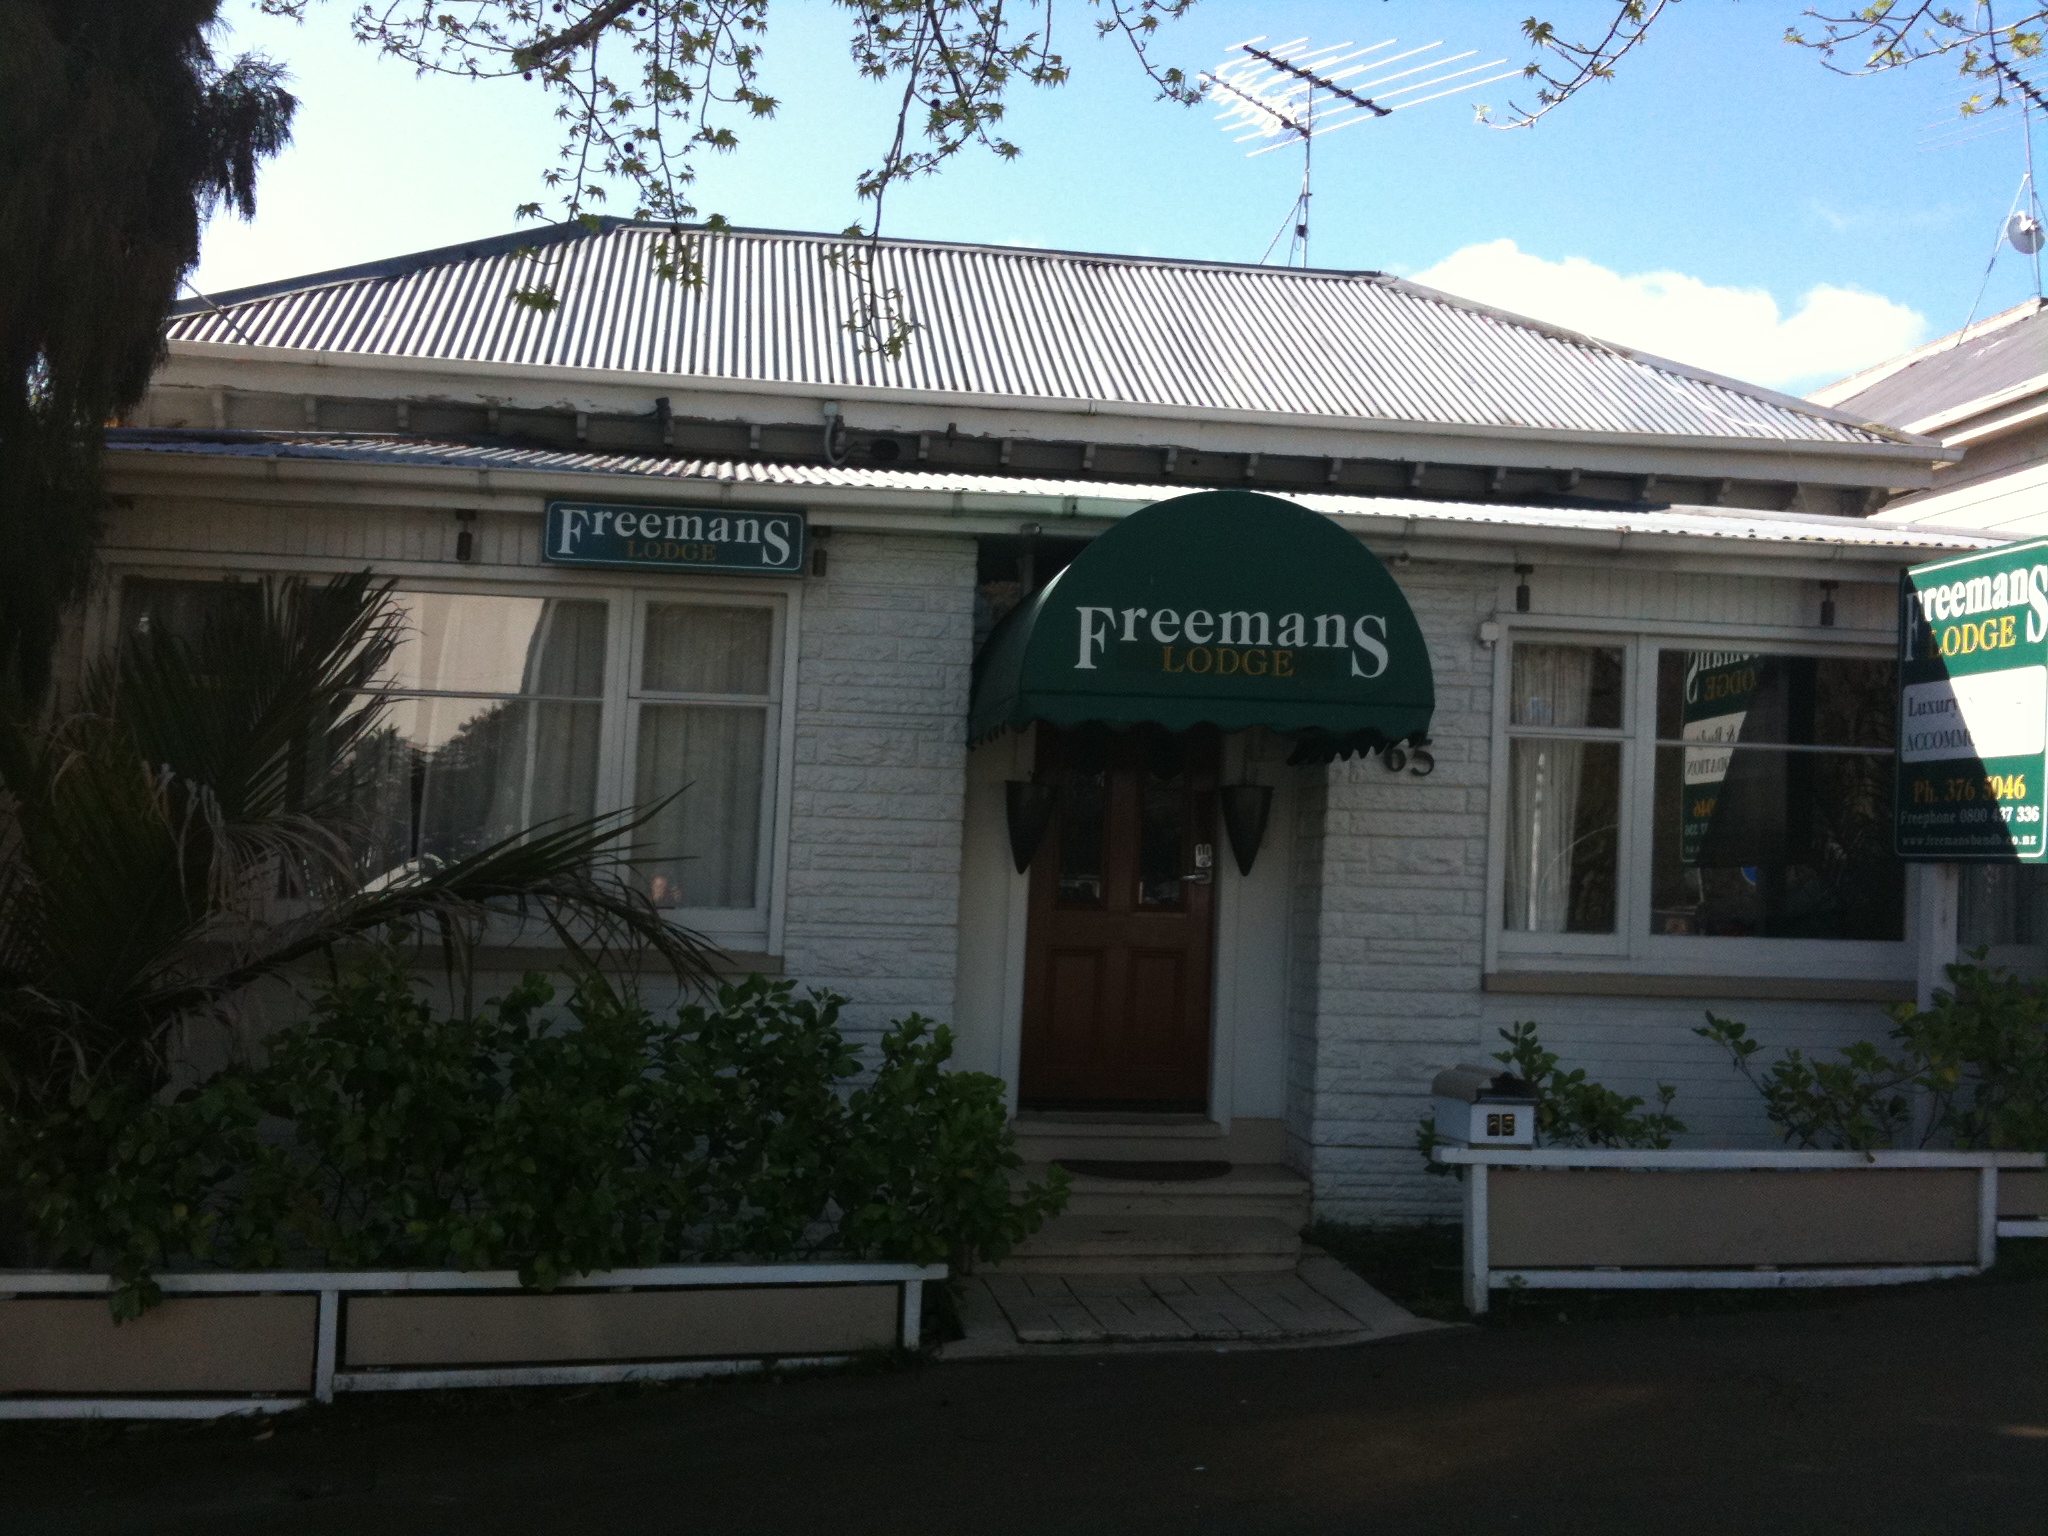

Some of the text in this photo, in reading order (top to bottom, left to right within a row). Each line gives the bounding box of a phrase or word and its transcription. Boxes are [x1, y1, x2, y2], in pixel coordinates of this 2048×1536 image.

[625, 540, 718, 562] LODGE
[1928, 615, 2017, 660] LODGE
[1161, 645, 1295, 677] LODGE
[1945, 778, 1976, 801] 376
[1959, 808, 1988, 823] 0800
[2016, 805, 2040, 823] 336
